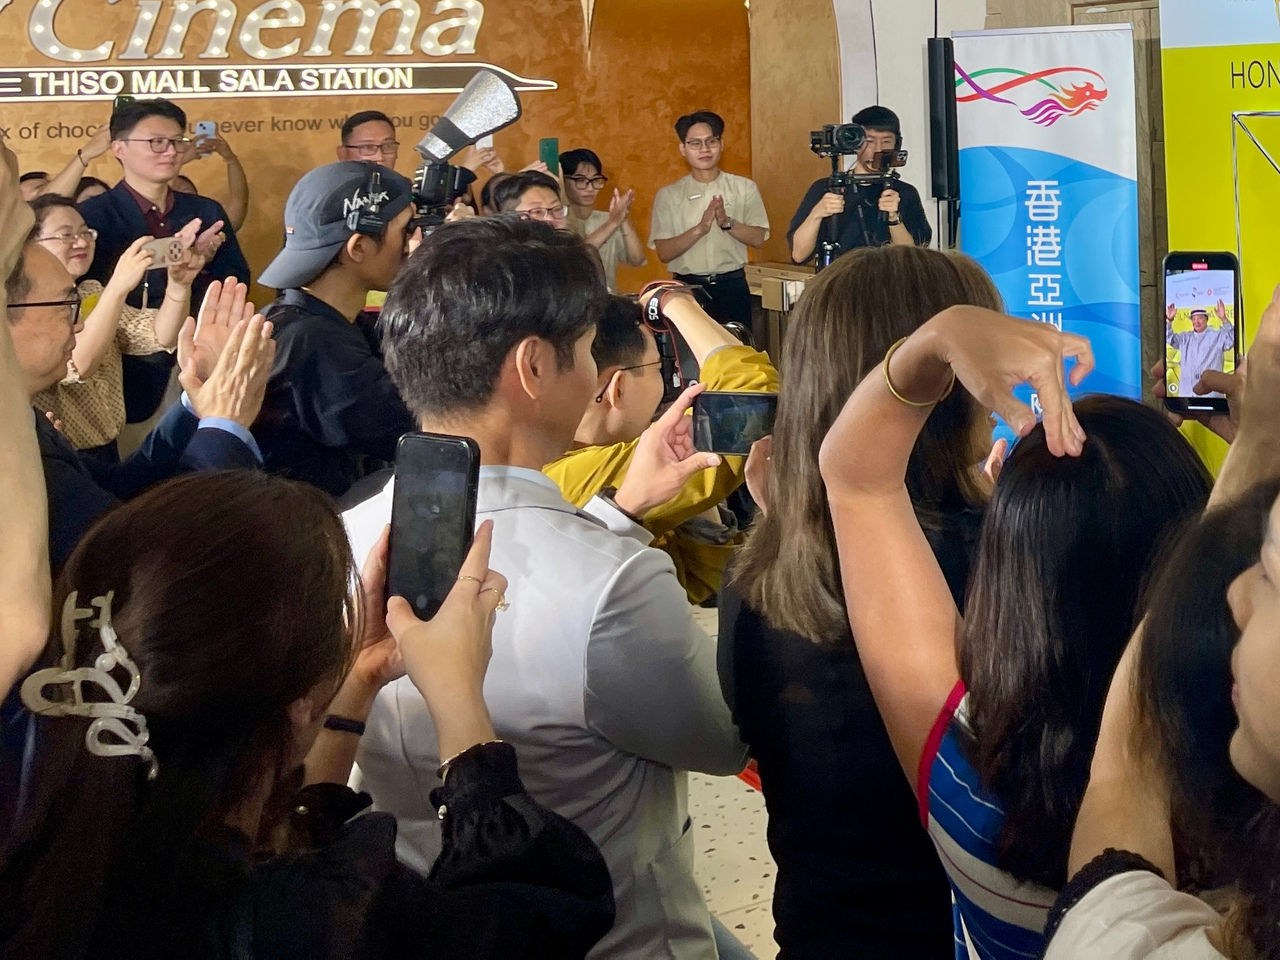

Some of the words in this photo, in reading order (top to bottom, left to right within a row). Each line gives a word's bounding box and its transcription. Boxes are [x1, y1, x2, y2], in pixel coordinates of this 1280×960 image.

[29, 70, 124, 96] THISO
[132, 69, 211, 94] MALL
[219, 68, 293, 92] SALA
[299, 67, 413, 91] STATION
[19, 122, 41, 139] of
[46, 121, 97, 138] choc
[271, 116, 320, 131] know
